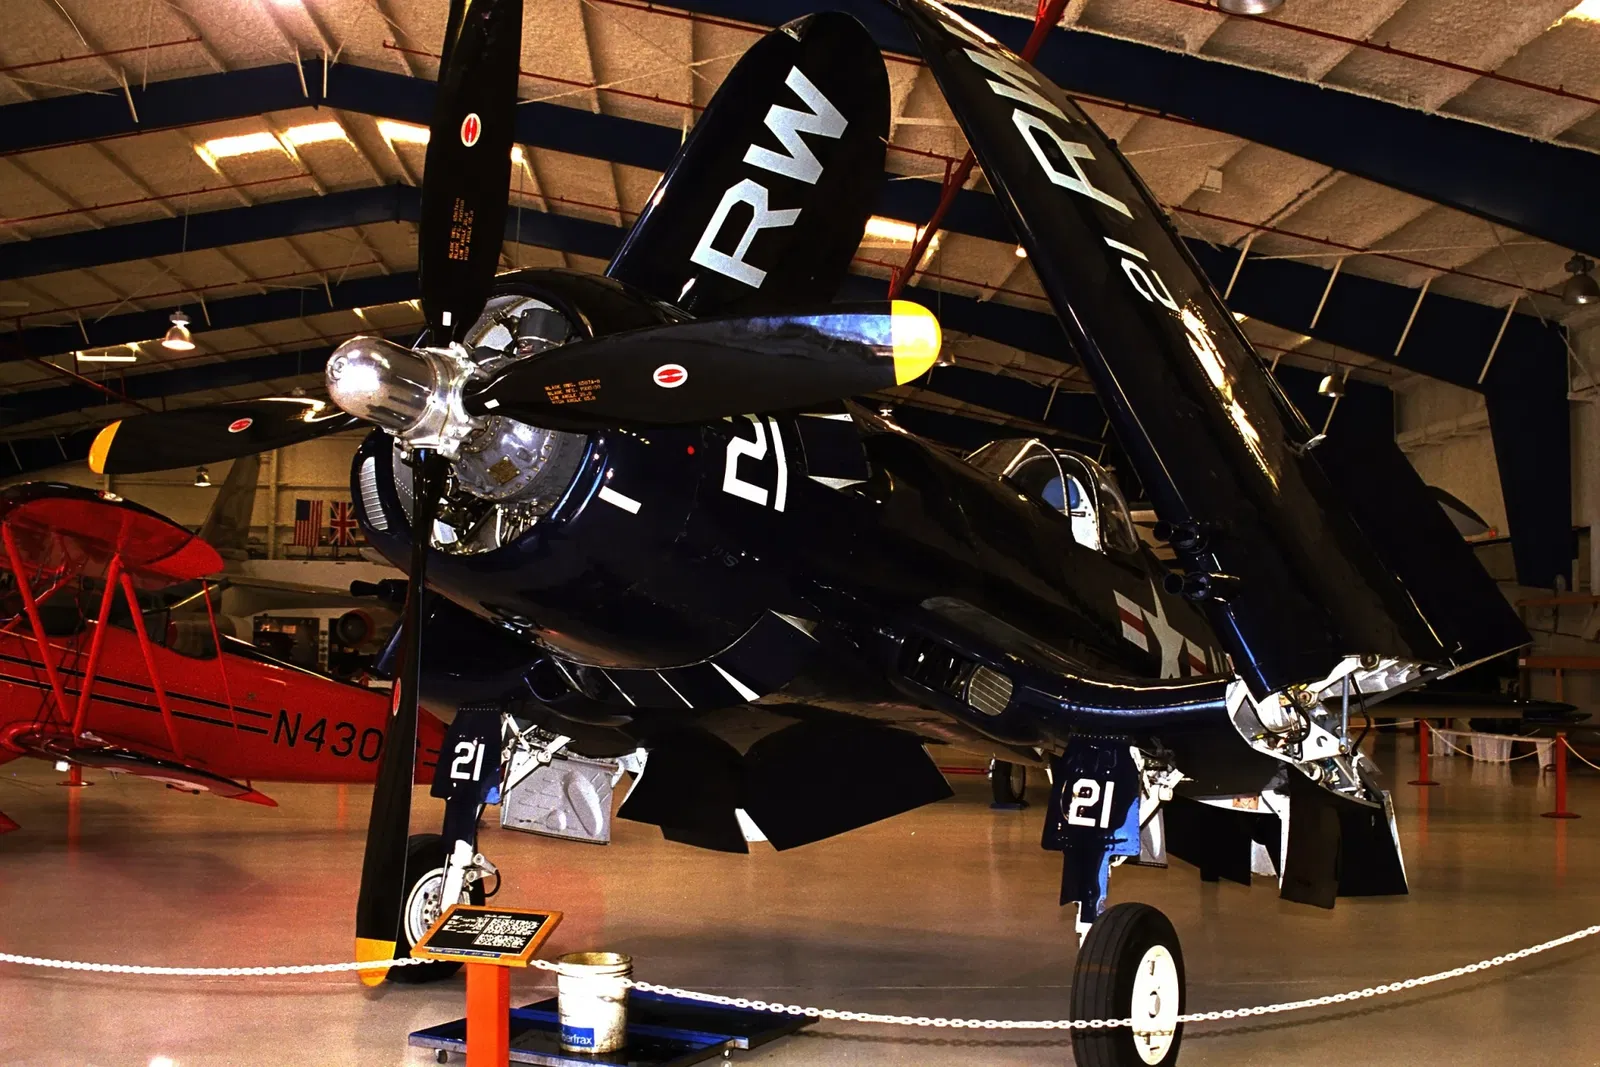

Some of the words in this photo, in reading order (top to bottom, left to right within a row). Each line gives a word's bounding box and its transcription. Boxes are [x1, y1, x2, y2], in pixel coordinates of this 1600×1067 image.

[689, 65, 849, 289] RW
[722, 413, 788, 513] 21
[273, 709, 385, 763] N430
[450, 741, 485, 781] 21
[1068, 778, 1115, 829] 21
